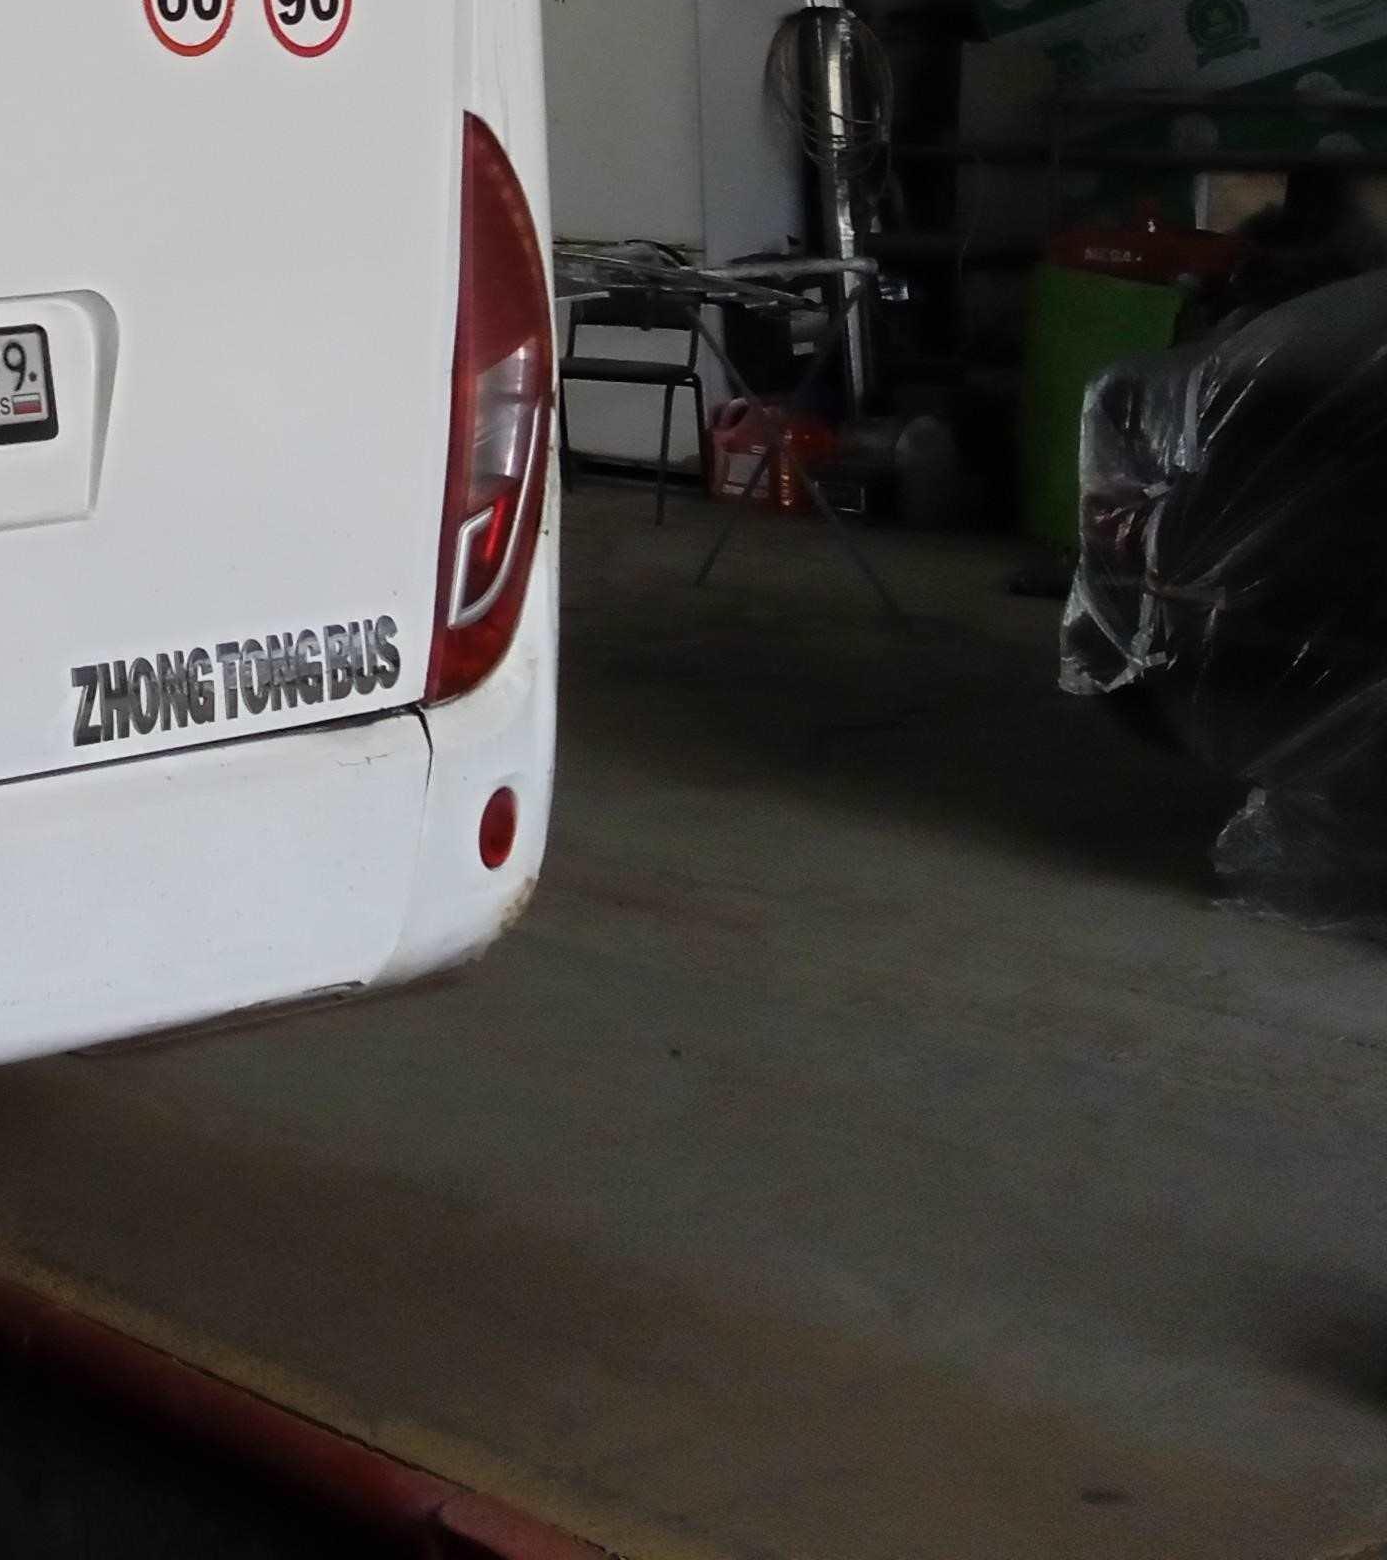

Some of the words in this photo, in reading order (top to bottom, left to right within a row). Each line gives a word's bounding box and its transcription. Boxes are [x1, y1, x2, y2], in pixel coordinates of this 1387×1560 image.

[71, 647, 215, 746] ZHONG
[216, 628, 324, 719] TONG
[323, 615, 401, 700] BUS
